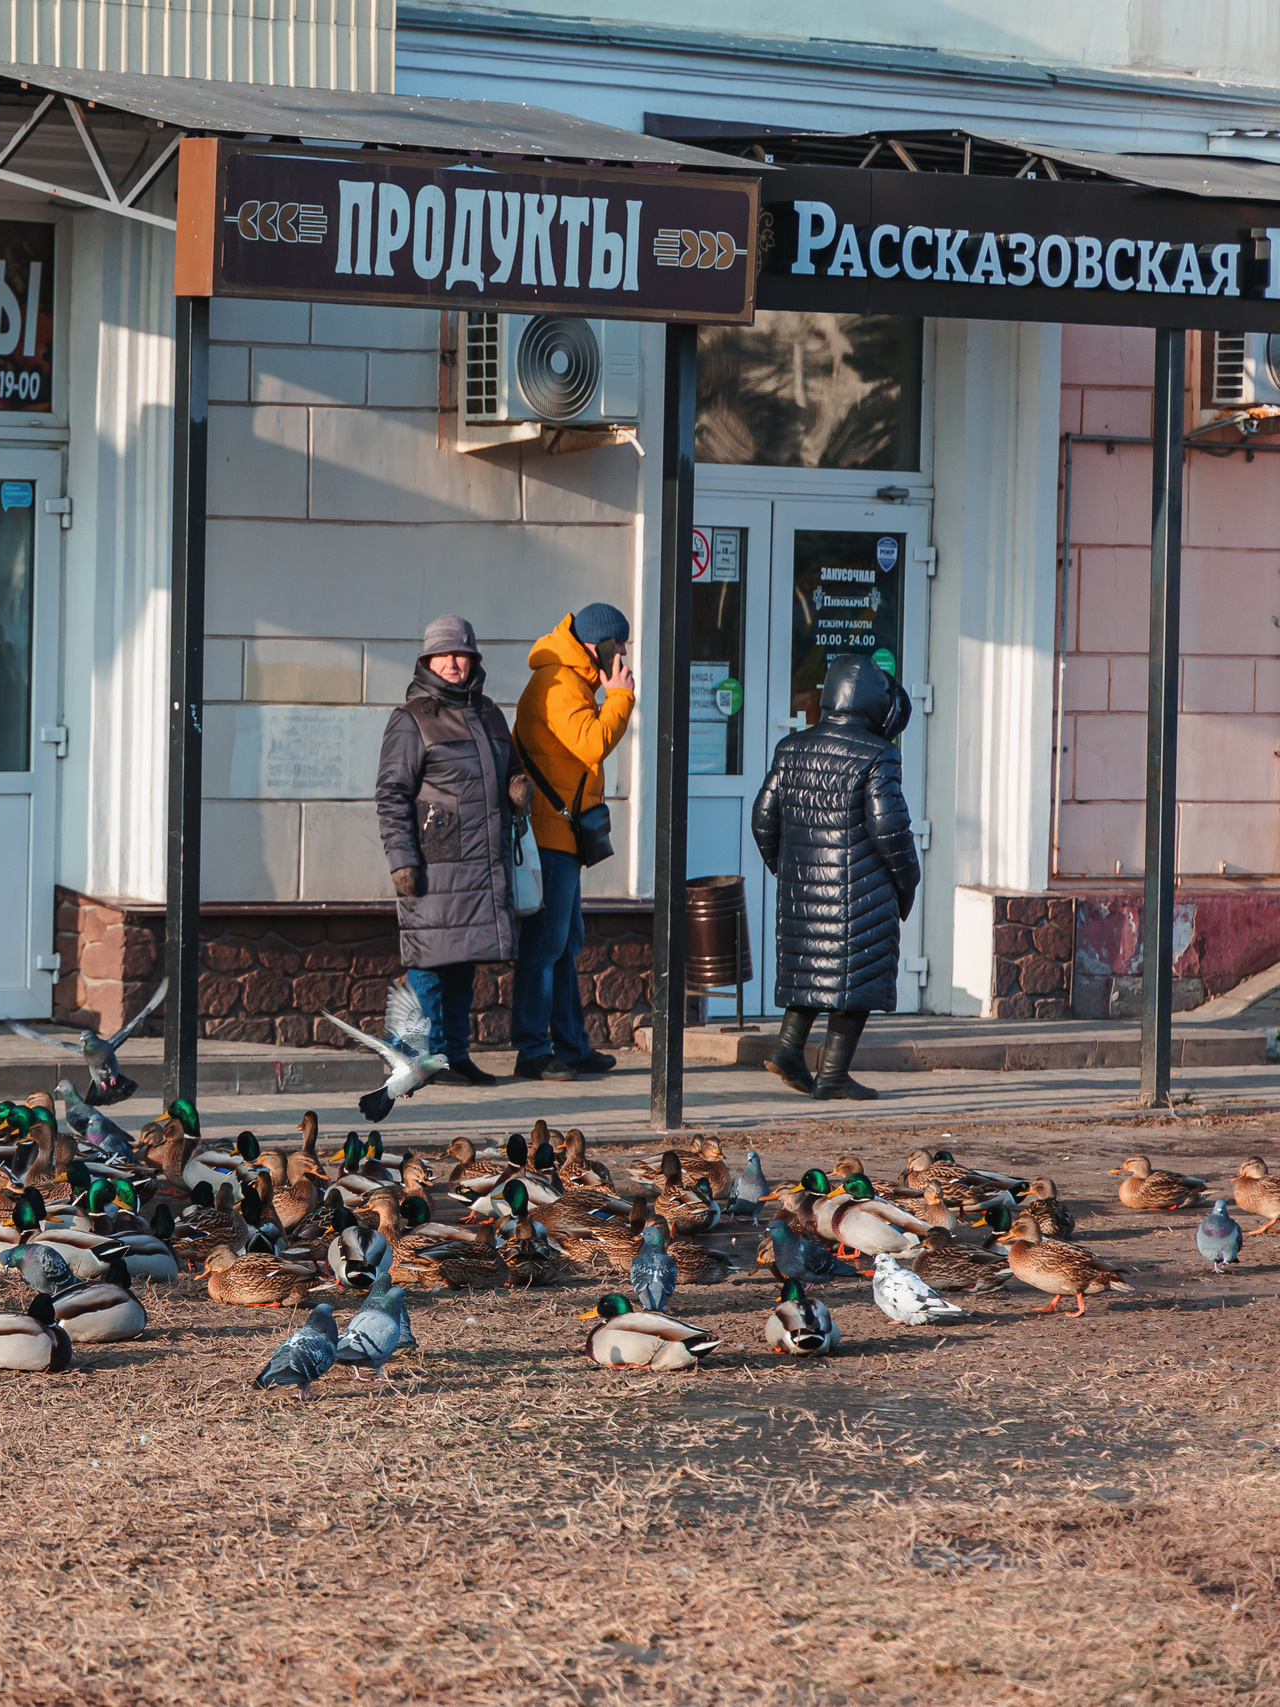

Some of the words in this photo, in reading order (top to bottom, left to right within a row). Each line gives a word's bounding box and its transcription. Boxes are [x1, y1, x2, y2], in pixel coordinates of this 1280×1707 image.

[334, 179, 643, 293] ПРОДУКТЫ
[0, 370, 41, 400] 19-00
[820, 566, 876, 583] ЗАКУСОЧНАЯ
[818, 619, 844, 629] РЕЖИМ
[845, 619, 873, 630] РАБОТЫ
[815, 633, 842, 646] 10.00
[848, 634, 876, 647] 24.00
